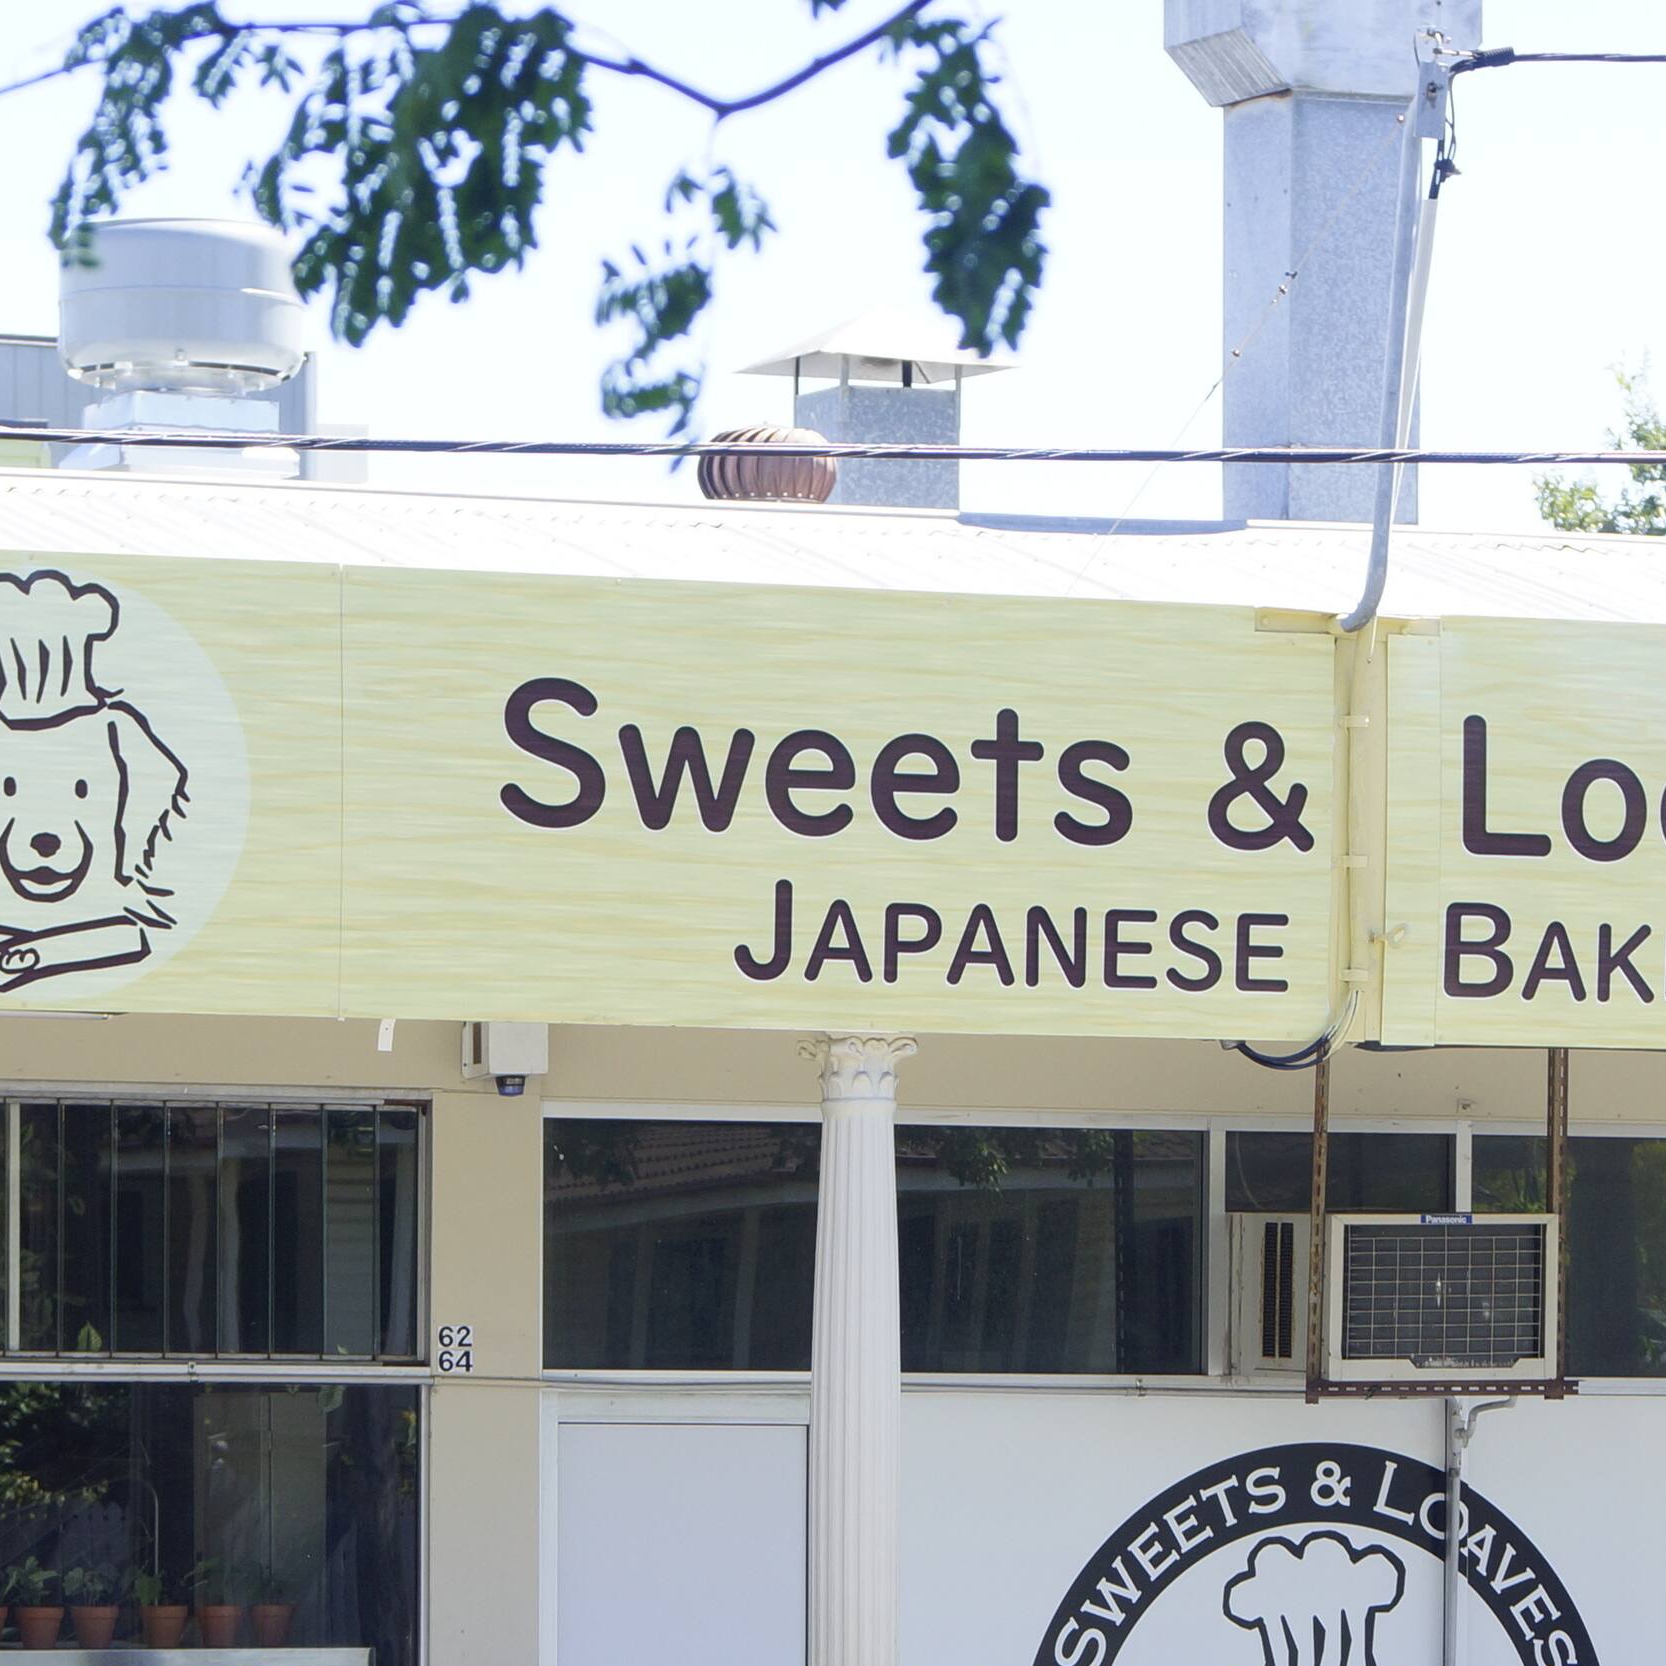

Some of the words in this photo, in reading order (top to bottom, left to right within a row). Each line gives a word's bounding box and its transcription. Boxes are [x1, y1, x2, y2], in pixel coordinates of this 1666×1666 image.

[499, 676, 1134, 847] Sweets
[1207, 720, 1315, 852] &
[733, 878, 1290, 993] JAPANESE
[1425, 1215, 1466, 1225] Panasonic
[438, 1325, 473, 1348] 62
[438, 1350, 473, 1372] 64
[1309, 1459, 1352, 1507] &
